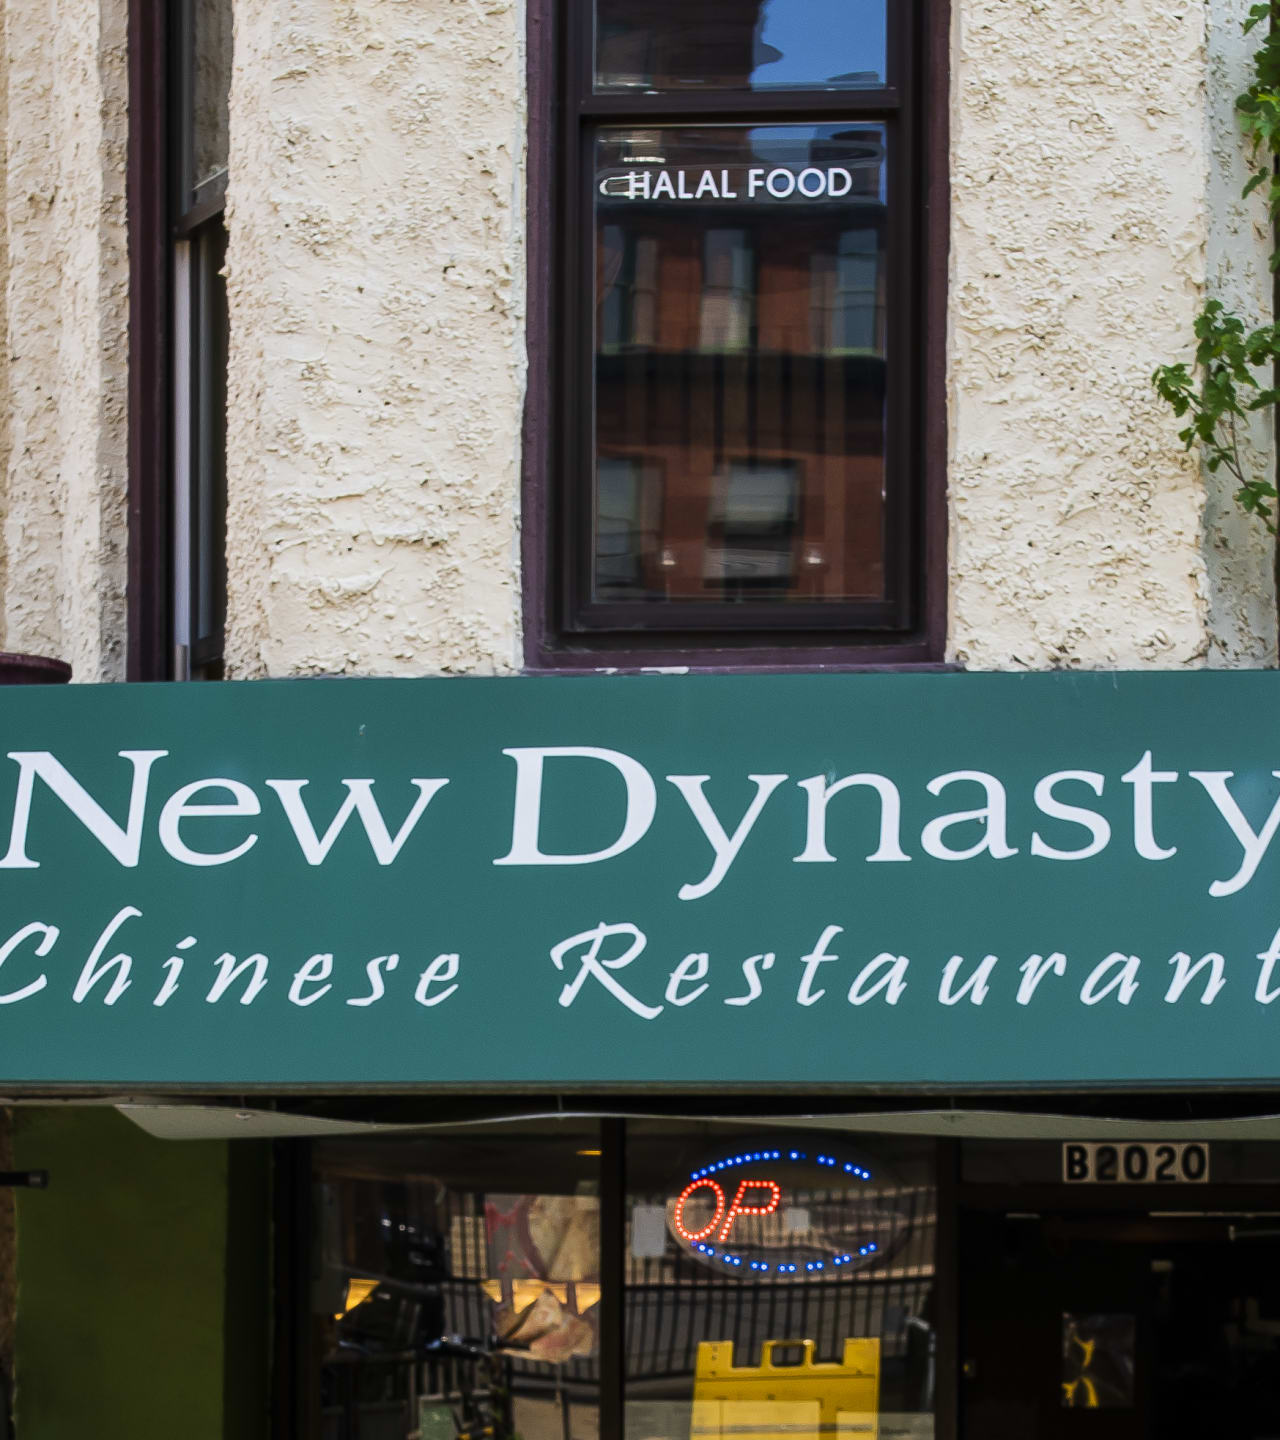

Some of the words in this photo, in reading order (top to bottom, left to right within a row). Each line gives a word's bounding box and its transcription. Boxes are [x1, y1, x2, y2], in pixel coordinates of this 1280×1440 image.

[629, 169, 737, 200] HALAL
[748, 167, 852, 198] FOOD
[1065, 1146, 1208, 1181] B2020
